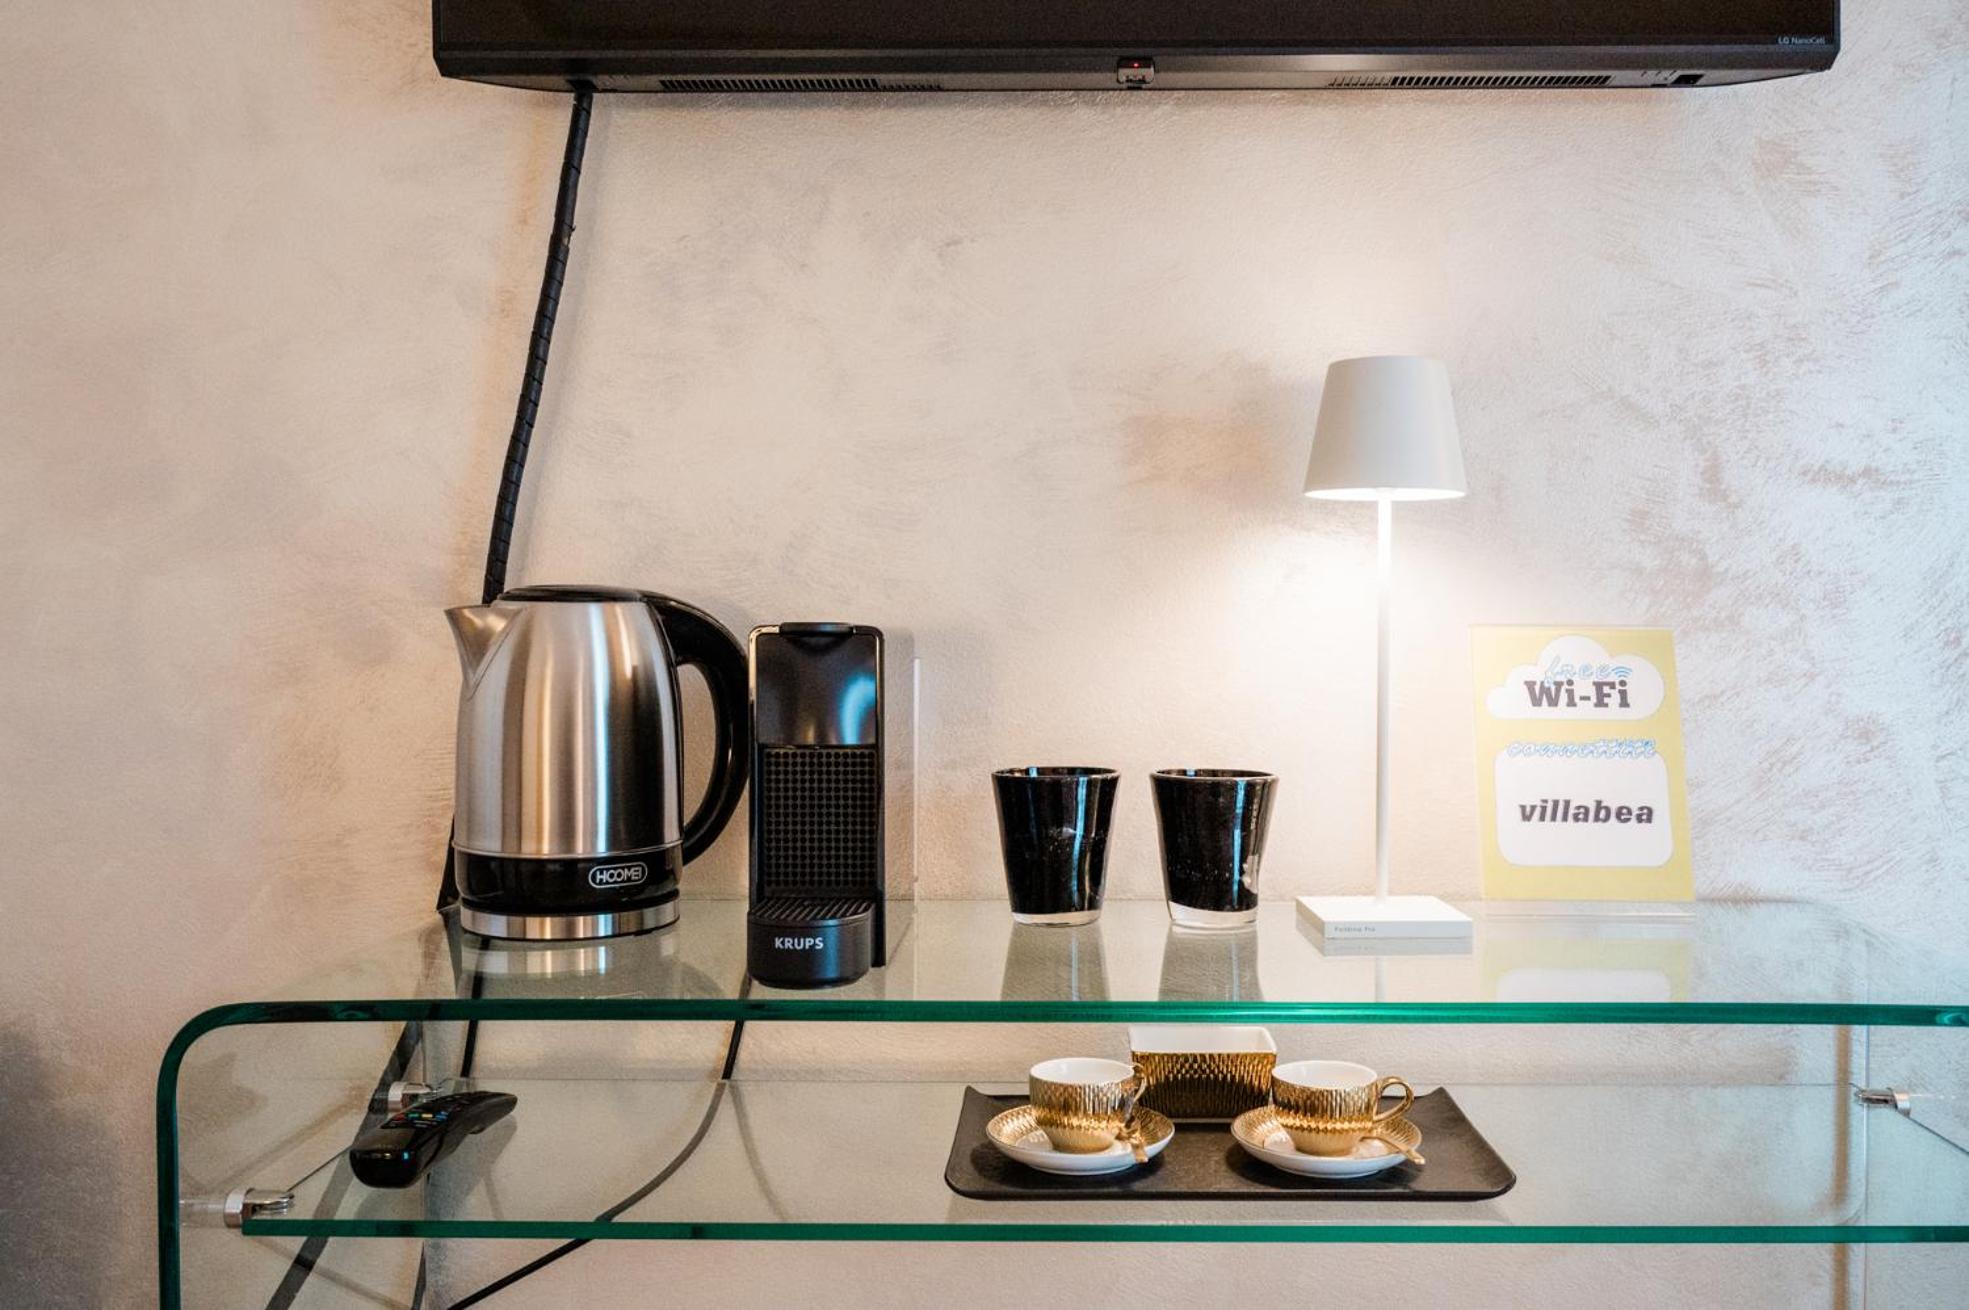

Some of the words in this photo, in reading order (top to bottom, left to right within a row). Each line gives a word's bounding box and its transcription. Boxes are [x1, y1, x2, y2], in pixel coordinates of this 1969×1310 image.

[1777, 36, 1789, 44] LG
[1524, 679, 1630, 708] Wi-Fi
[1518, 799, 1654, 824] villabea
[774, 936, 824, 950] KRUPS
